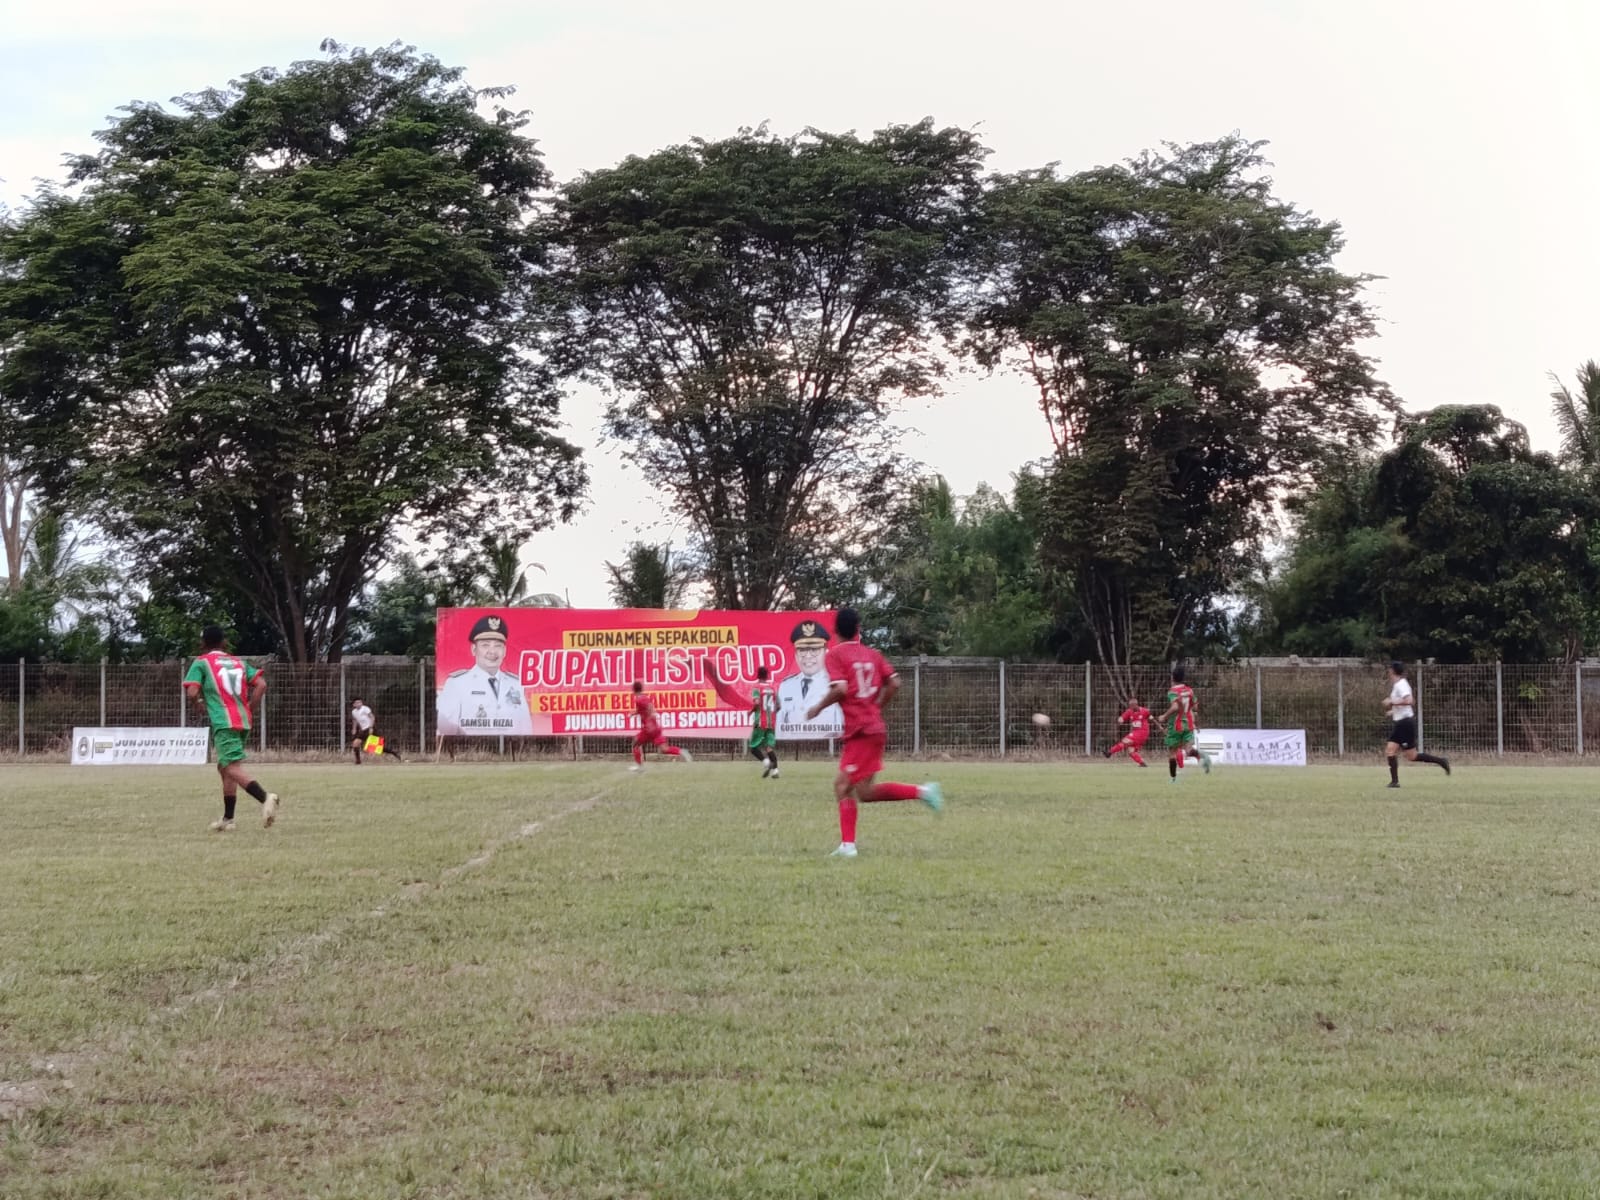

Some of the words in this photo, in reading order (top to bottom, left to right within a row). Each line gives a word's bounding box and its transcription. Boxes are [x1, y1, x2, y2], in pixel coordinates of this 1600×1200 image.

[569, 631, 651, 648] TOURNAMEN
[656, 629, 735, 645] SEPAKBOLA
[520, 648, 636, 688] BUPATI
[643, 646, 709, 685] HST
[716, 644, 786, 685] CUP
[218, 667, 244, 696] 17
[539, 694, 608, 712] SELAMAT
[611, 691, 707, 711] BERANDING
[460, 718, 491, 728] SAMSUL
[493, 718, 514, 728] RIZAL
[564, 713, 626, 731] JUNJUNG
[115, 739, 165, 747] JUNJUNG
[169, 739, 205, 747] TINGGI
[1226, 742, 1302, 750] SELAMAT
